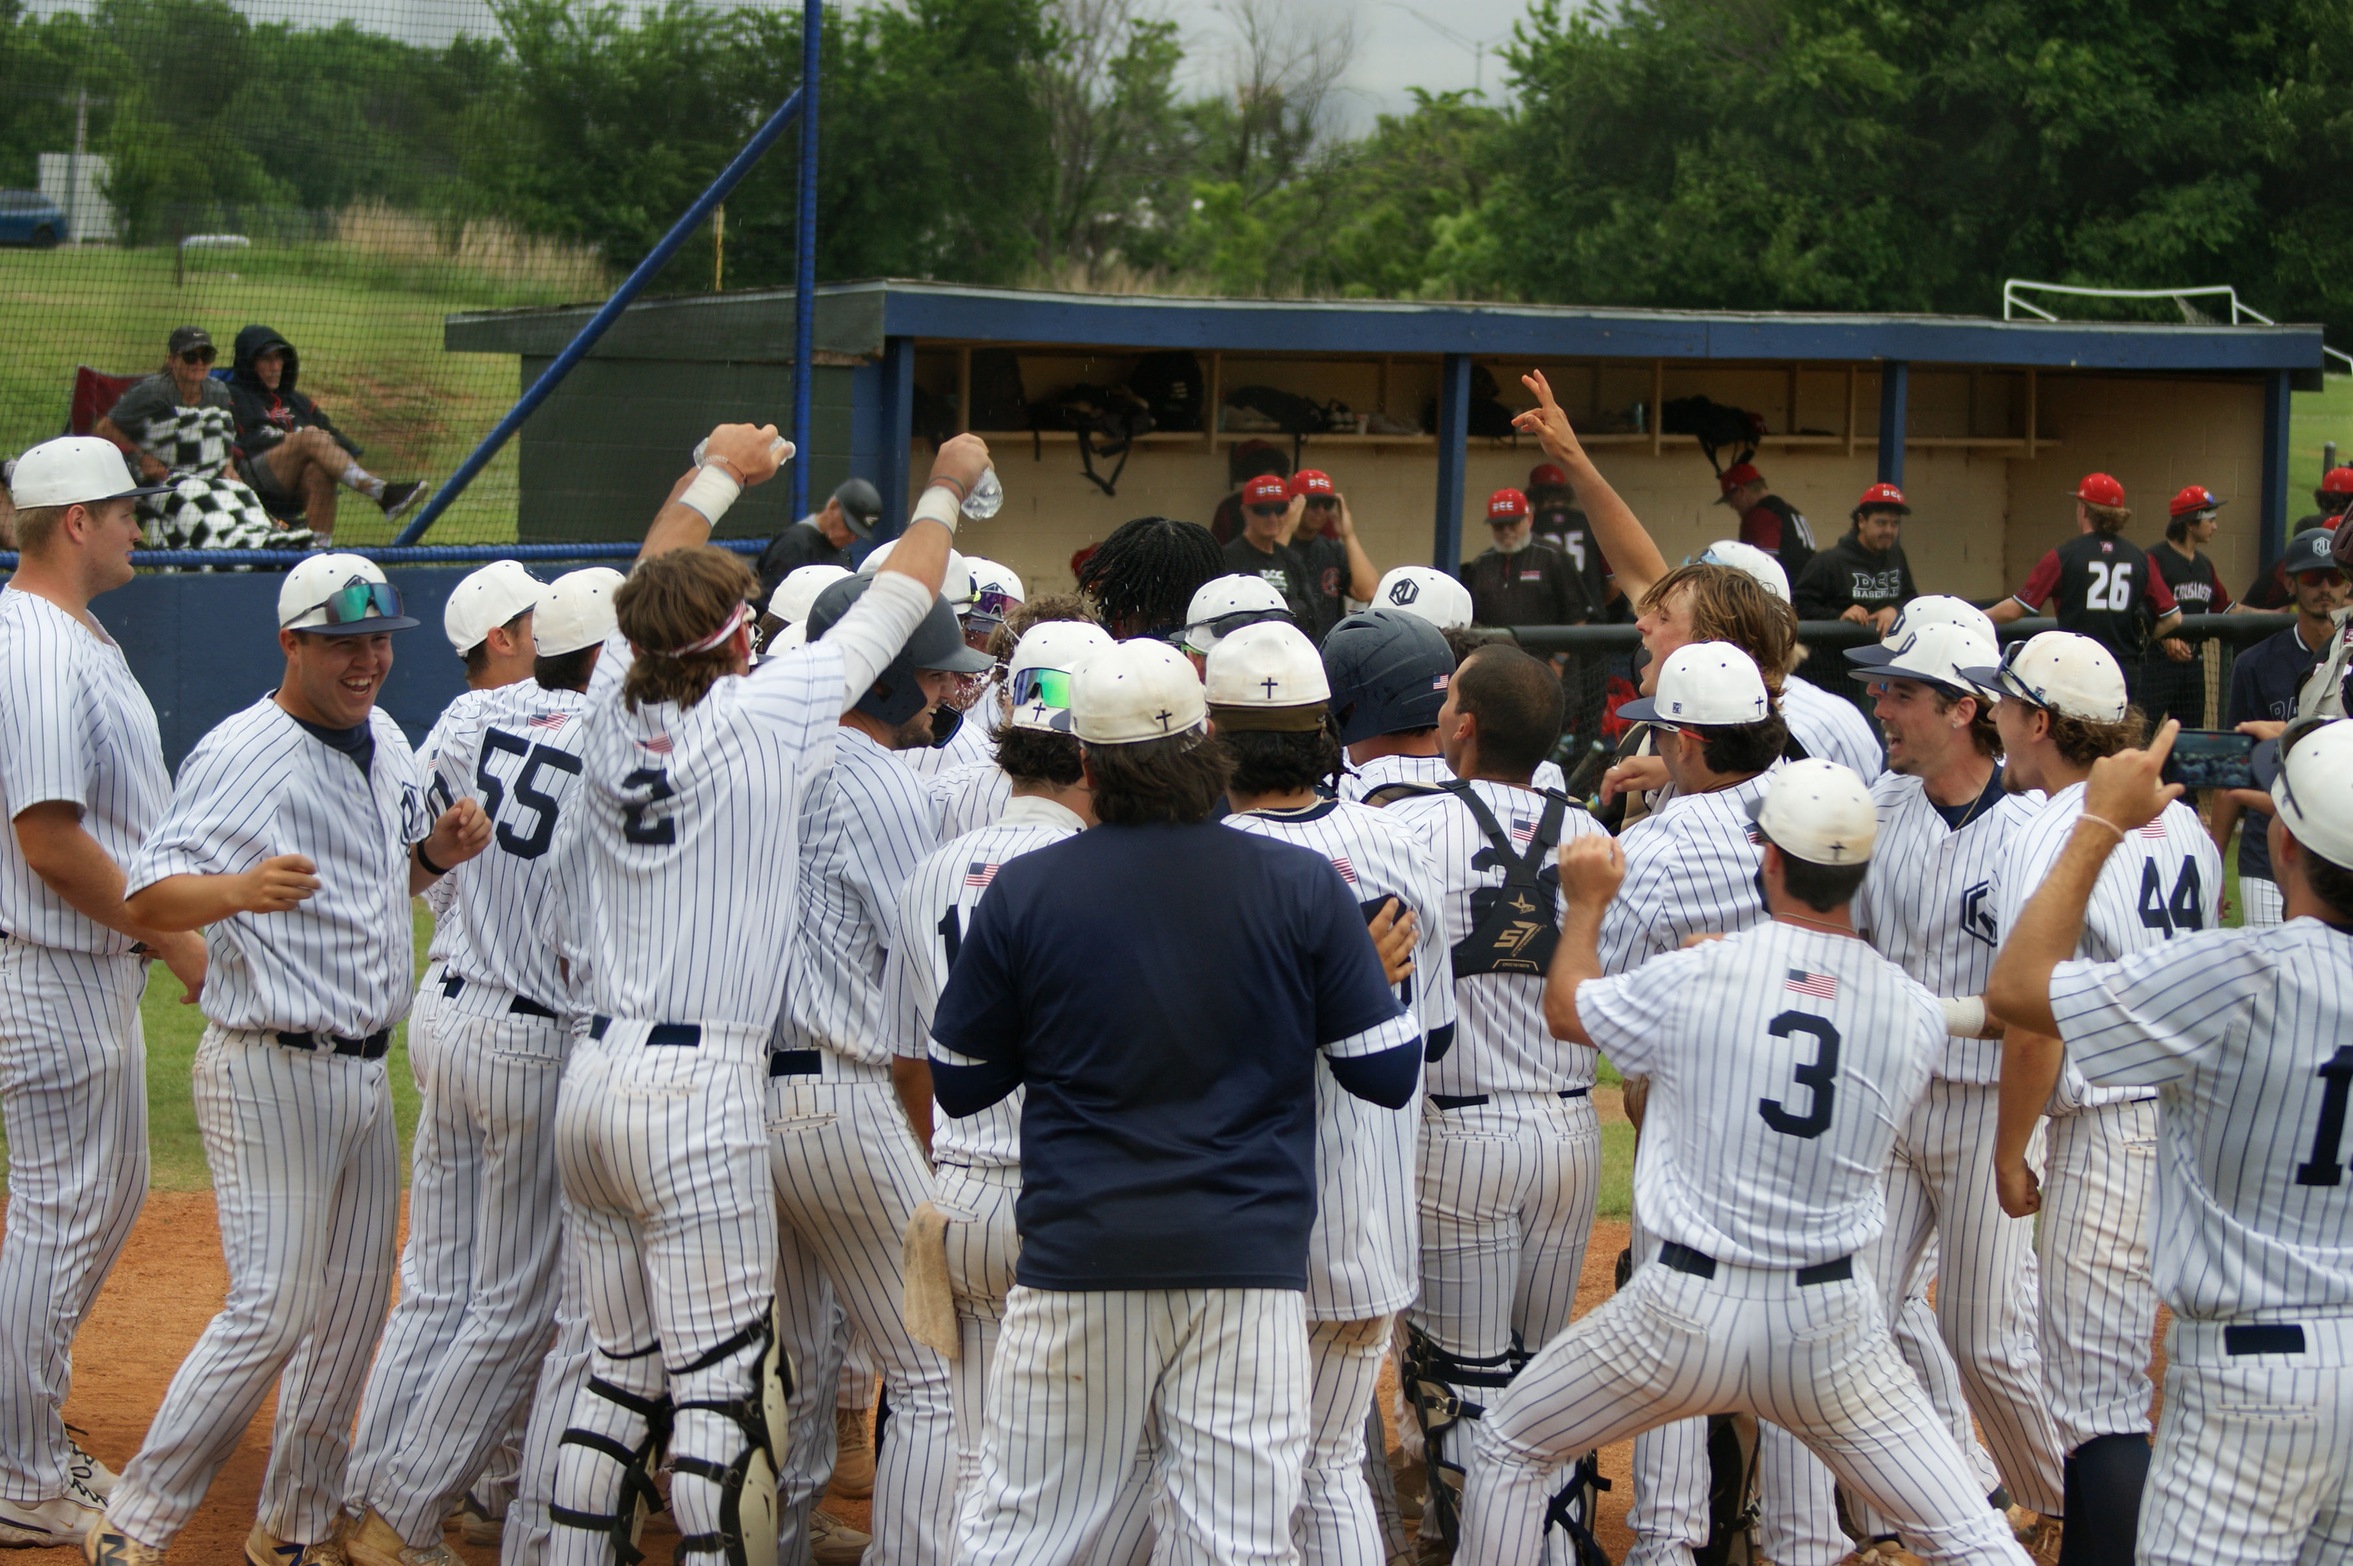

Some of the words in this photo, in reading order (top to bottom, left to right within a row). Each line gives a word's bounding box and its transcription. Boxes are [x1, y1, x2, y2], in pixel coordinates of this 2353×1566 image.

[1257, 485, 1283, 495] DCC
[1309, 479, 1331, 489] DCC
[1882, 489, 1902, 501] DCC
[1492, 501, 1514, 512] DCC
[1791, 513, 1816, 550] 40
[1388, 578, 1420, 606] RU
[1851, 568, 1900, 591] DCC
[2086, 561, 2133, 611] 26
[476, 727, 583, 860] 55
[621, 767, 676, 845] 2
[2138, 855, 2204, 939] 44
[1758, 1009, 1841, 1140] 3
